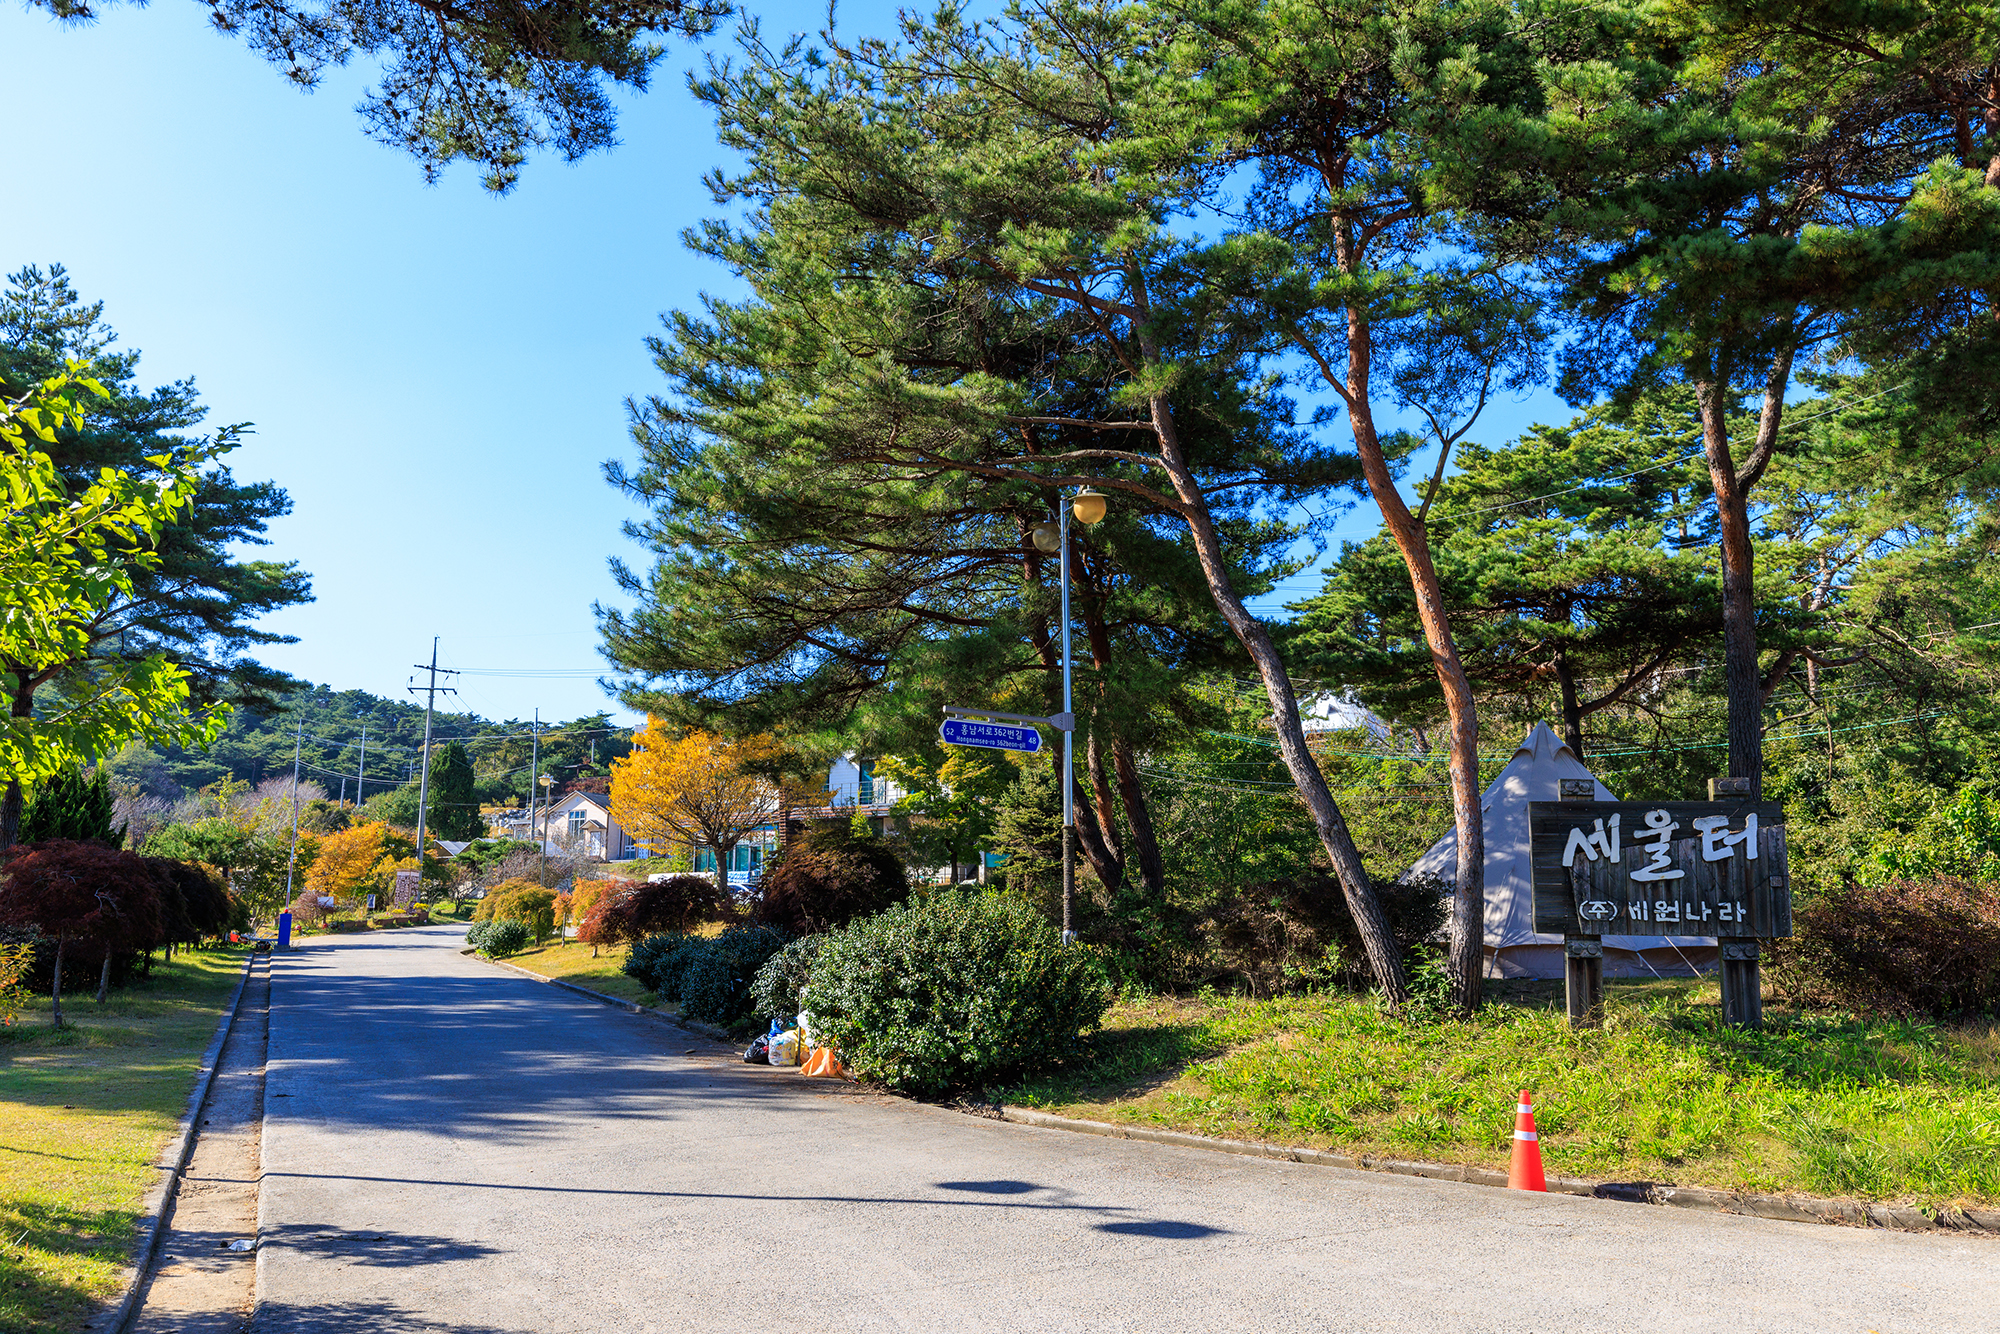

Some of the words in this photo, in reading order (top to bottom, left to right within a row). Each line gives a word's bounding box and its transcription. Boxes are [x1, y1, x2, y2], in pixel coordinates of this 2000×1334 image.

[946, 727, 955, 736] 52
[961, 724, 1023, 741] 홍남서로362번길
[956, 735, 995, 745] Hongnamseo-ro
[996, 739, 1026, 749] 362beon-gil
[1028, 736, 1037, 745] 48
[1562, 808, 1758, 882] 세울터
[1579, 900, 1618, 921] (주)
